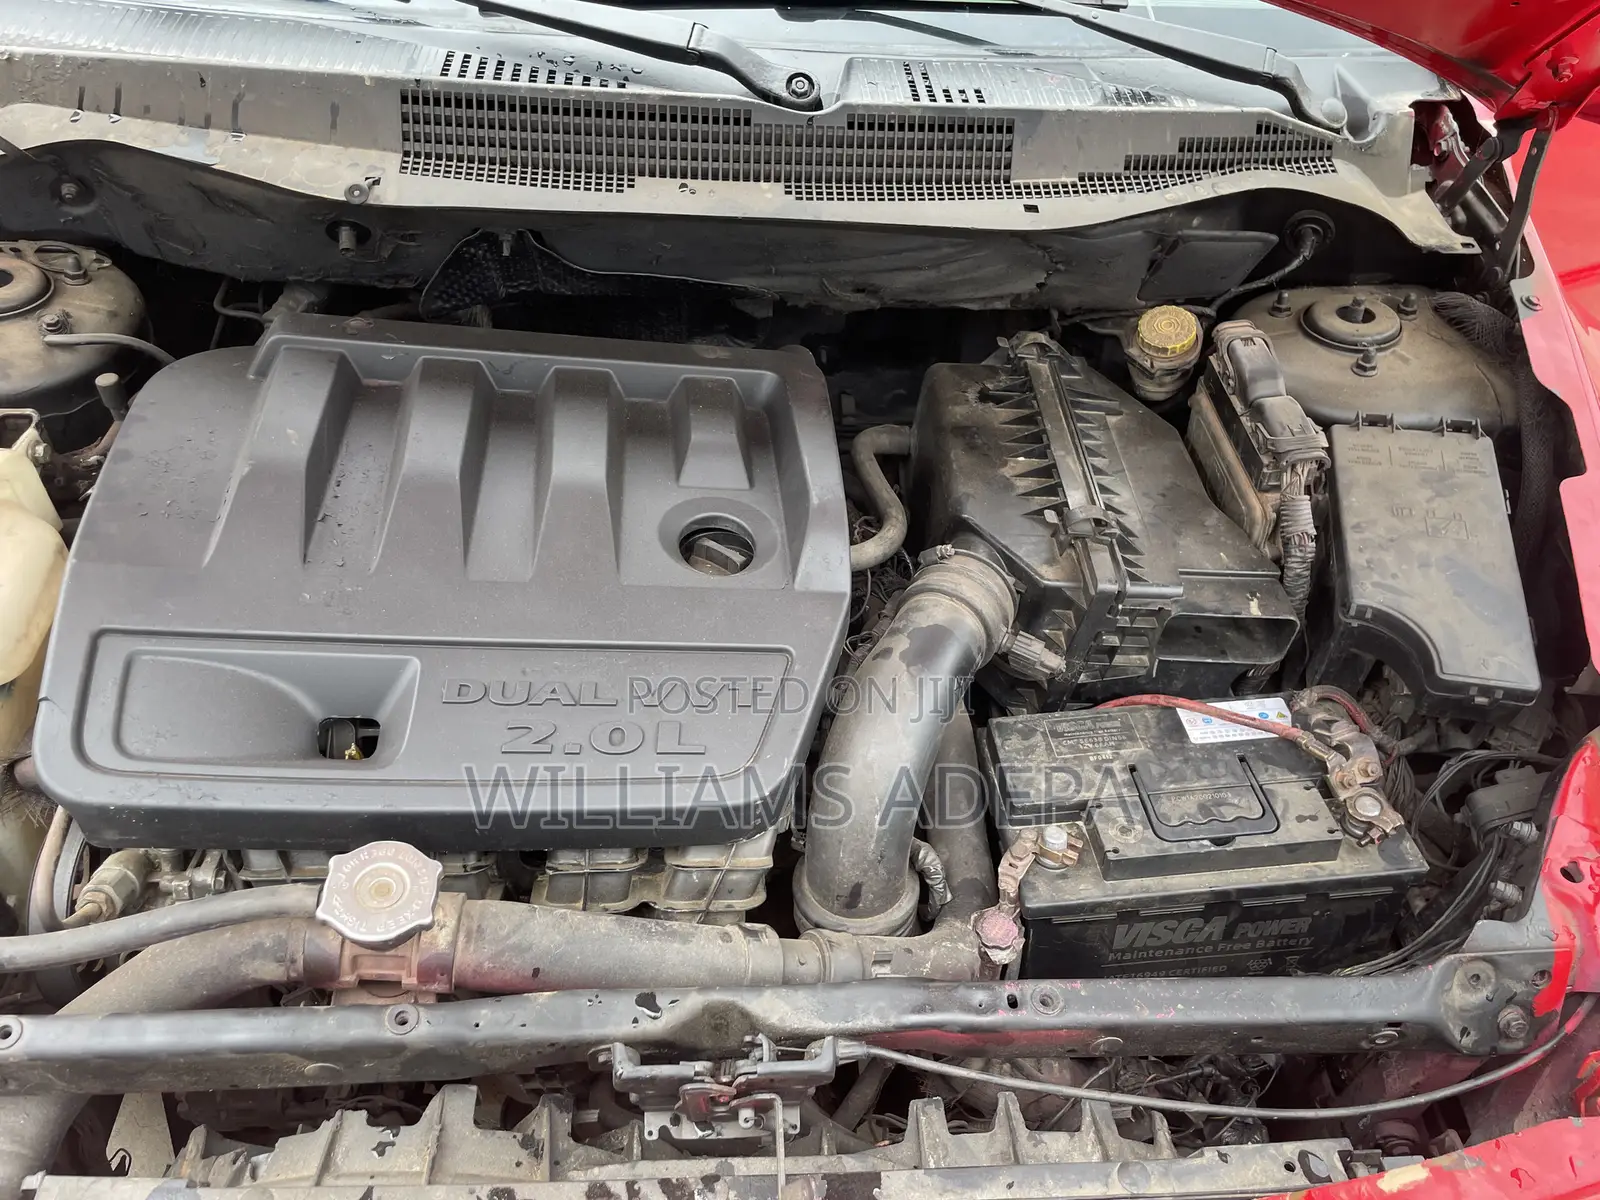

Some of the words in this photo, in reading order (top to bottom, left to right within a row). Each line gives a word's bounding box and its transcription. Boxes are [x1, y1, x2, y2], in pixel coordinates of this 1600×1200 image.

[441, 679, 617, 706] DUAL
[501, 720, 706, 755] 2.0L
[1112, 916, 1228, 949] VISCA
[1233, 917, 1313, 939] POWER
[1108, 944, 1214, 962] Maintenance
[1217, 941, 1252, 952] Free
[1256, 936, 1315, 949] Battery
[1168, 965, 1228, 977] CERTIFIED
